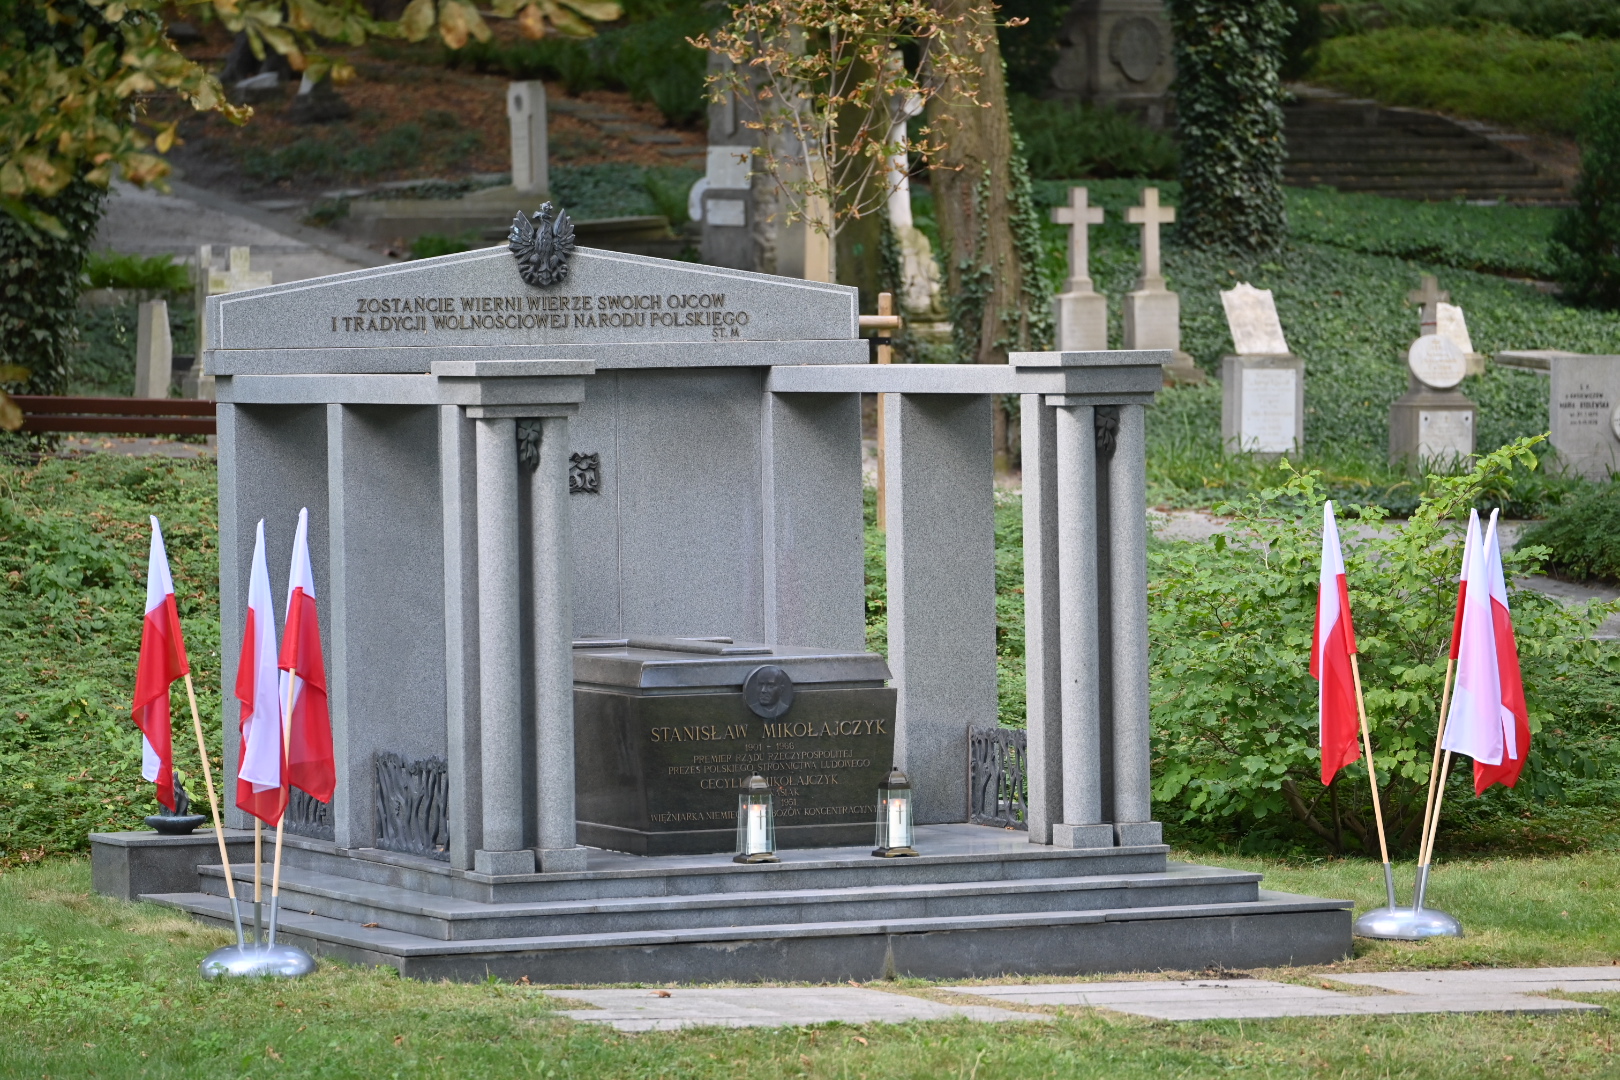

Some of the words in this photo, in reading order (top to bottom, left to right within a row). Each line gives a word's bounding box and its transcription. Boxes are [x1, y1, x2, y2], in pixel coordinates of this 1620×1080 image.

[357, 296, 455, 313] ZOSTAŃCIE
[460, 296, 523, 312] WIERNI
[526, 295, 593, 311] WIERZE
[597, 294, 662, 310] SWOICH
[331, 316, 337, 332] I
[342, 316, 427, 332] TRADYCJI
[432, 312, 569, 329] WOLNOŚCIOWEJ
[574, 312, 646, 328] NARODU
[650, 311, 750, 327] POLSKIEGO
[650, 724, 749, 742] STANISŁAW
[762, 719, 888, 739] MIKOŁAJCZYK
[745, 743, 762, 752] 1901
[776, 742, 795, 751] 1966
[693, 755, 732, 764] PREMIER
[735, 753, 765, 764] RZĄDU
[768, 749, 853, 761] RZECZYPOSPOLITEJ
[668, 766, 701, 775] PREZES
[704, 763, 754, 774] POLSKIEGO
[758, 761, 817, 771] STRONNICTWA
[820, 759, 871, 769] LUDOWEGO
[700, 778, 742, 790] CECYLI
